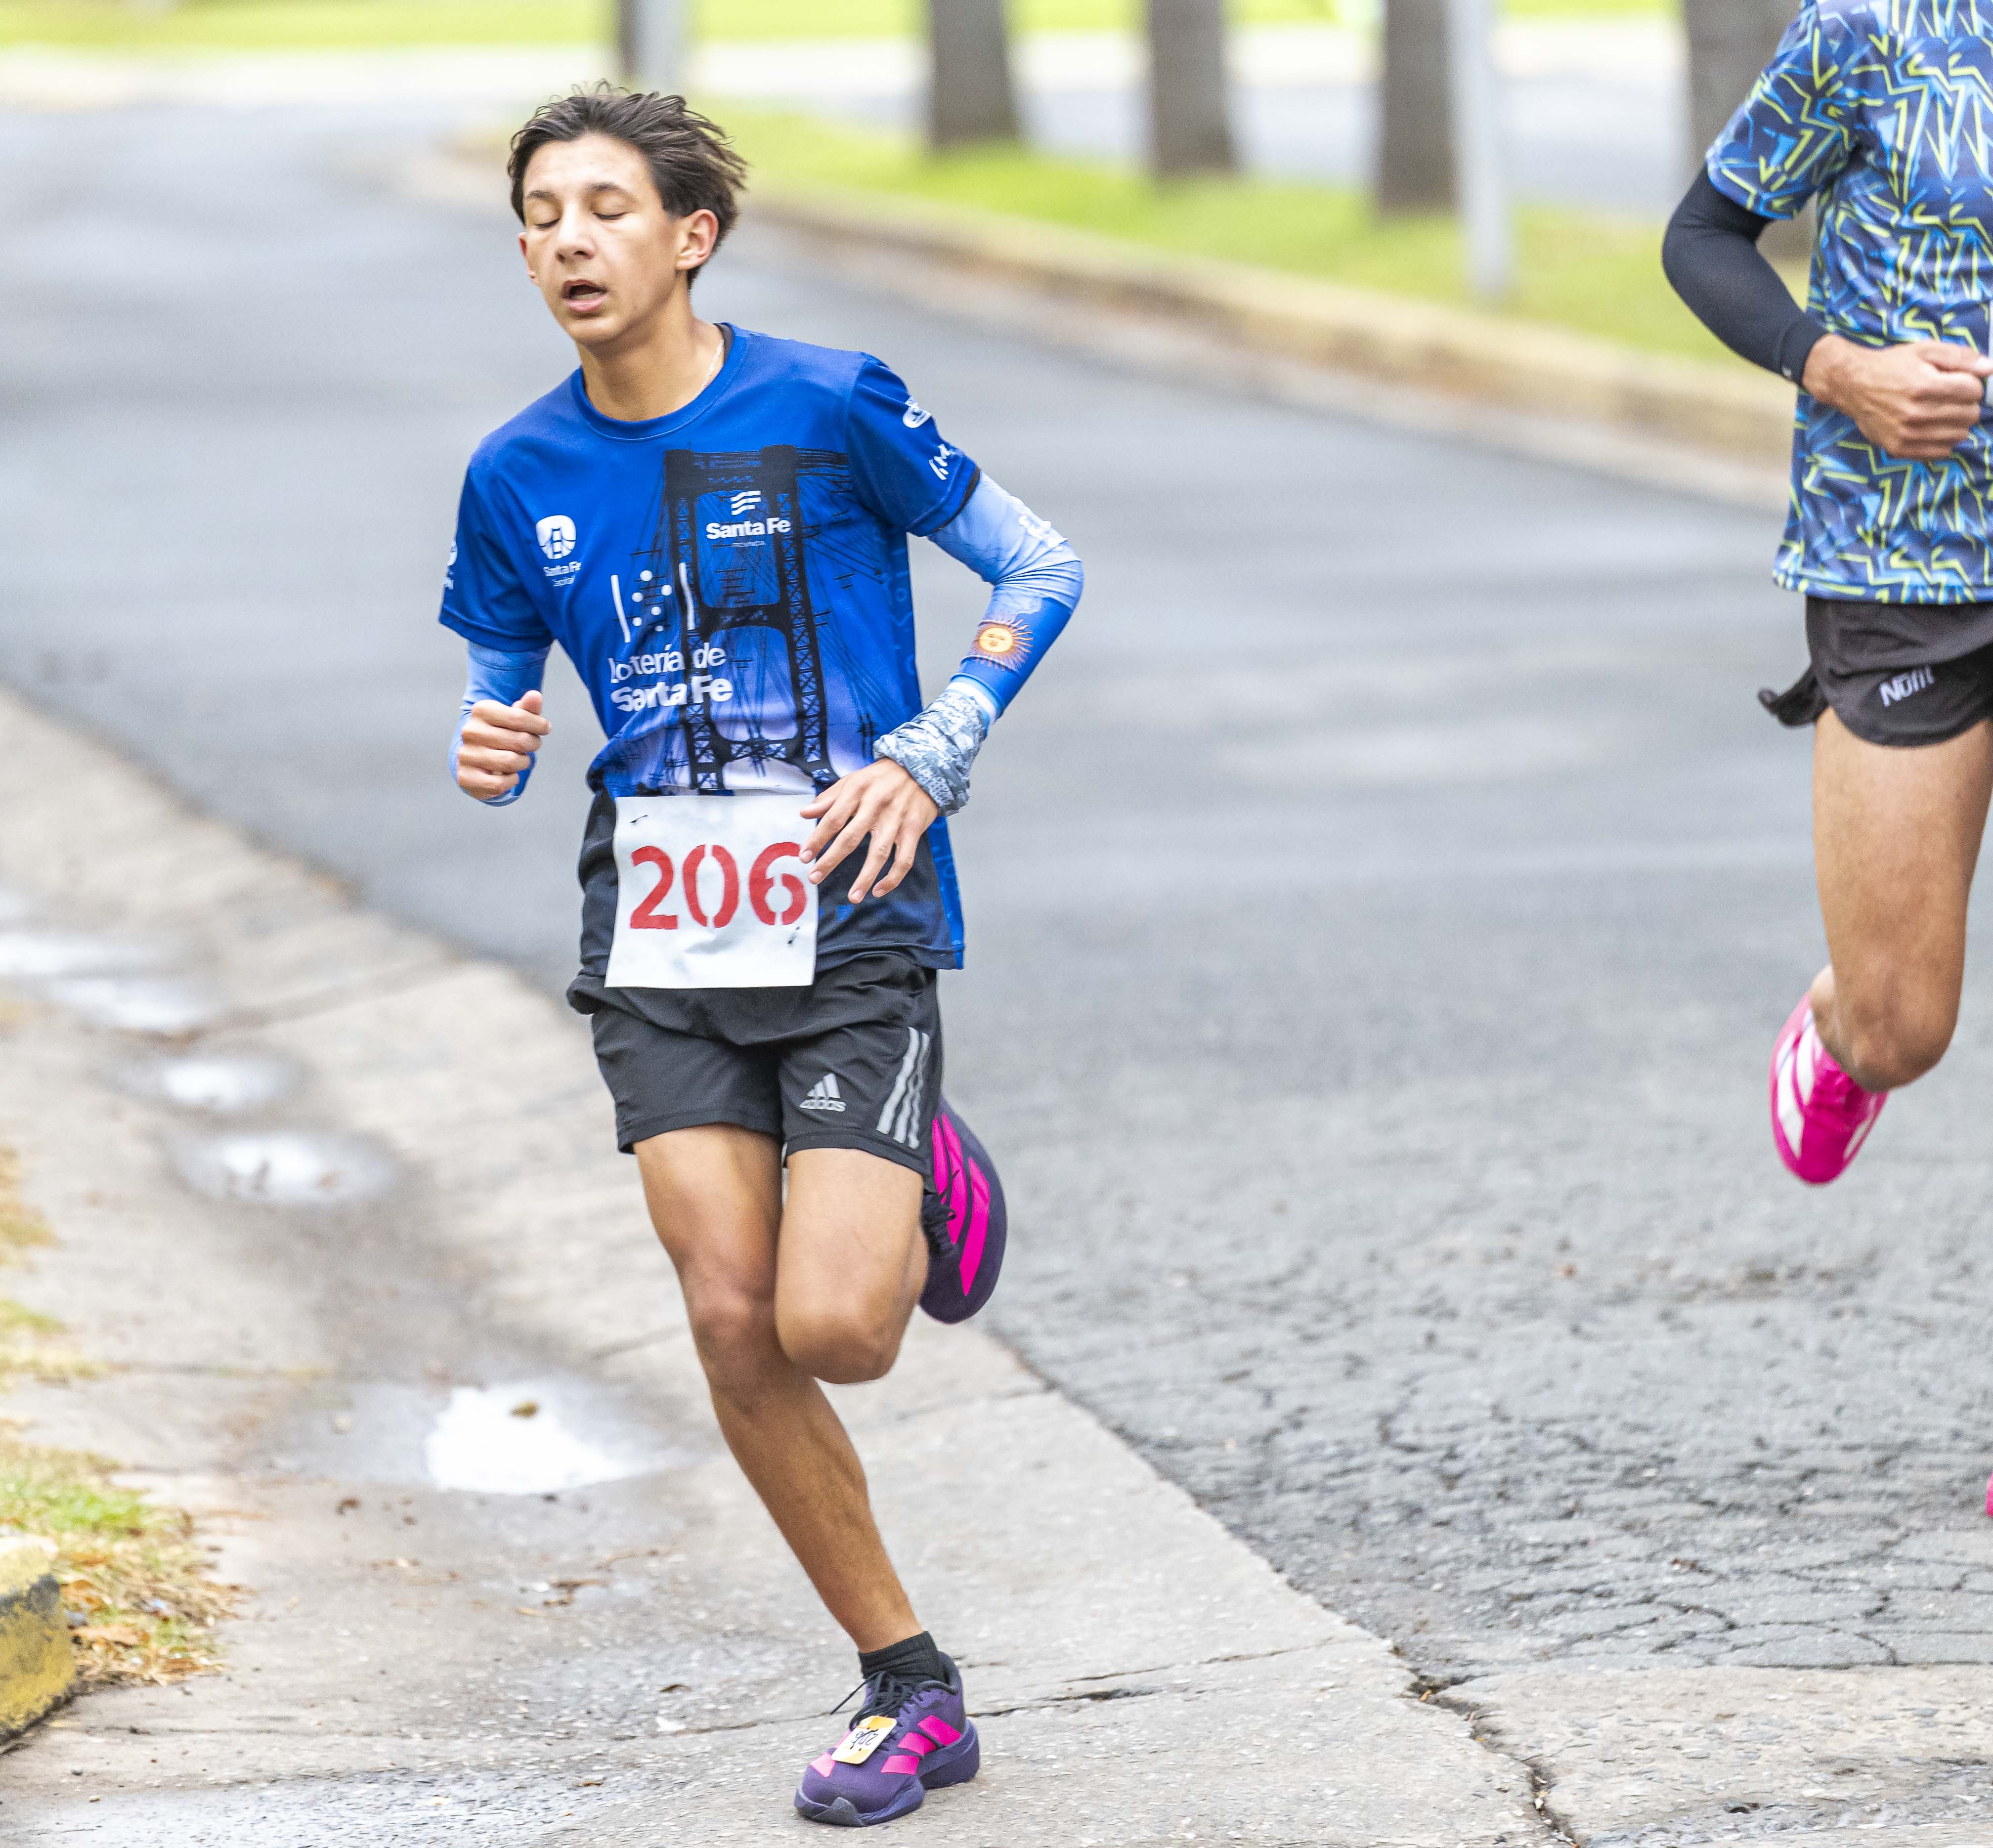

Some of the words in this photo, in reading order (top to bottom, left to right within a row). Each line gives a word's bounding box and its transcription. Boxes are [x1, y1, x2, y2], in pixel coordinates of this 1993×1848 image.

[705, 520, 766, 539] Santa
[766, 517, 791, 534] Fe
[607, 644, 685, 684] lotería
[693, 643, 727, 669] de
[610, 682, 688, 712] Santa
[692, 674, 734, 704] Fe
[629, 841, 808, 930] 206
